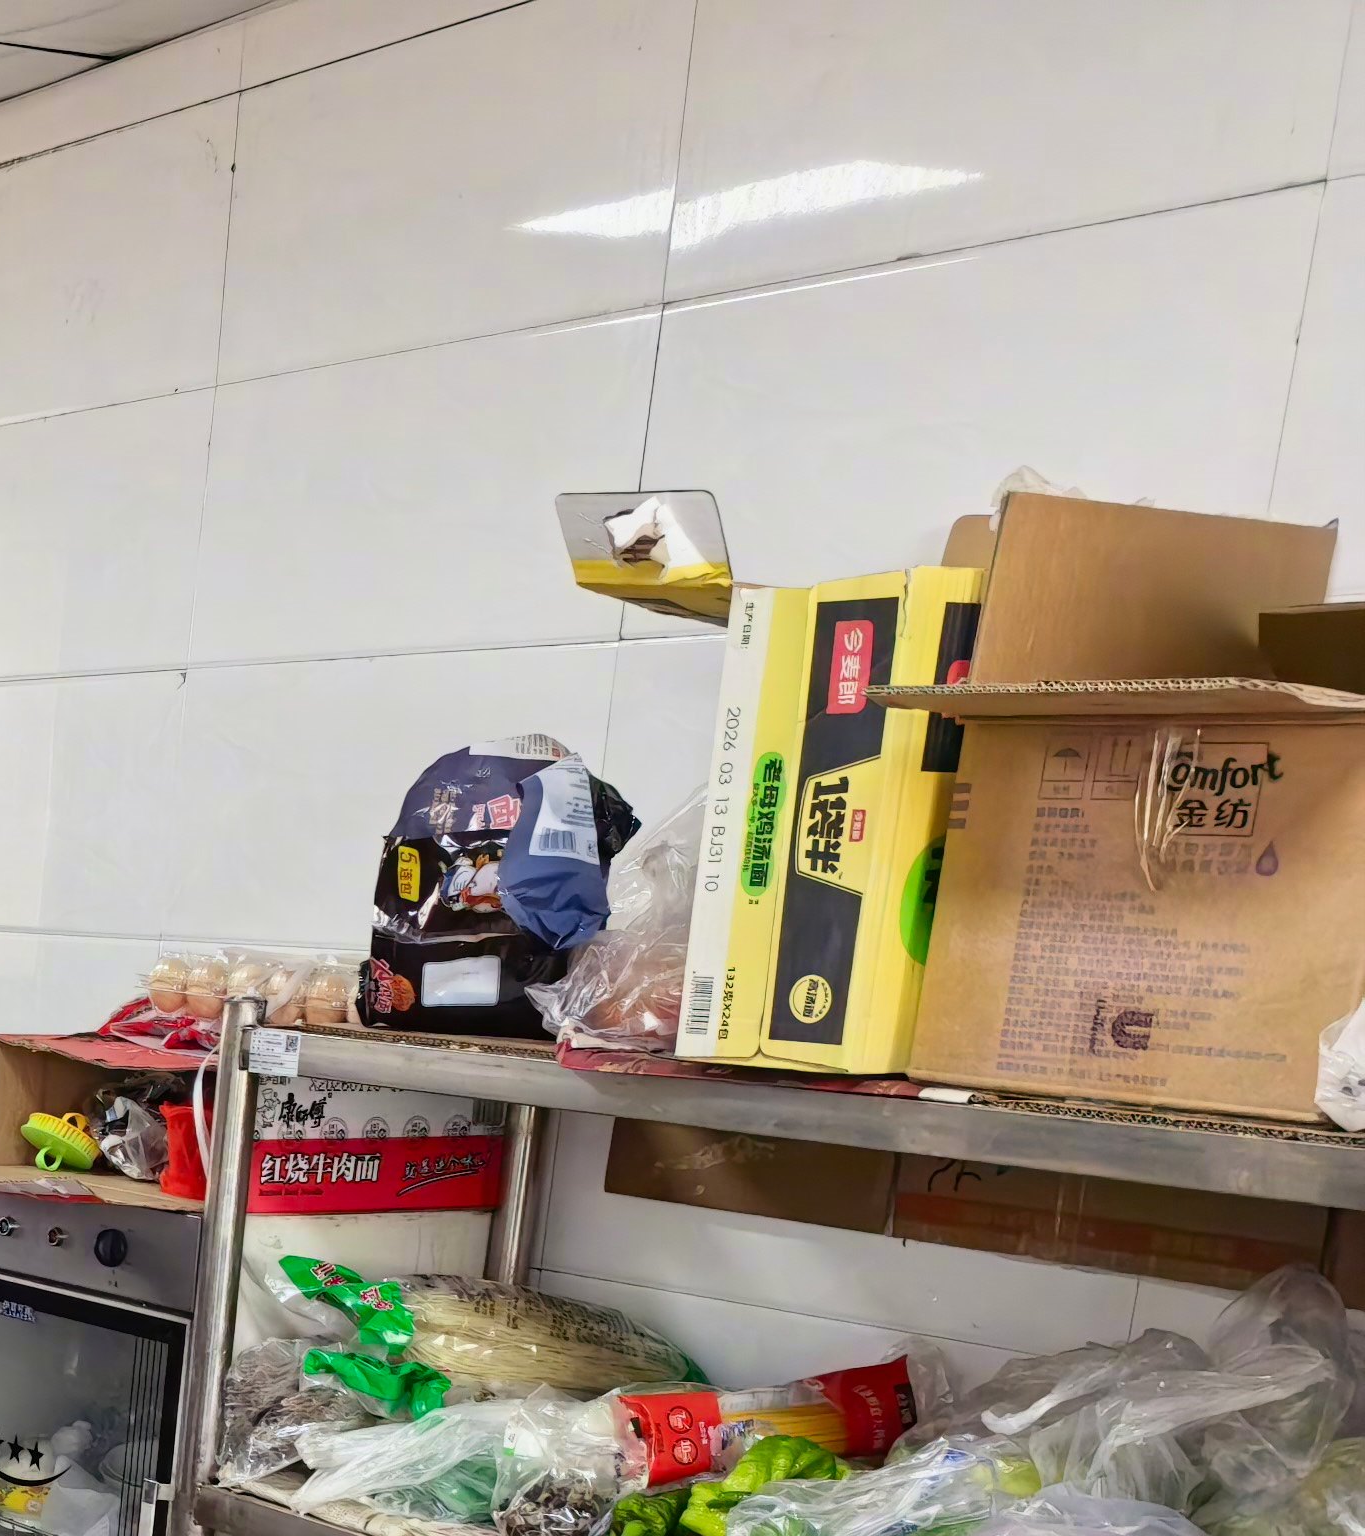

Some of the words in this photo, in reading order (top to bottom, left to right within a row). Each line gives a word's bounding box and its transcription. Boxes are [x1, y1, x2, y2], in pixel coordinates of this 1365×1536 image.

[837, 627, 865, 706] 今麦郎
[722, 706, 742, 752] 2026
[718, 761, 735, 786] 03
[713, 796, 729, 817] 13
[749, 757, 785, 888] 老母鸡汤面
[1173, 797, 1254, 830] 金纺
[703, 873, 720, 892] 10
[278, 1092, 327, 1129] 康师傅
[259, 1152, 382, 1185] 红烧牛肉面
